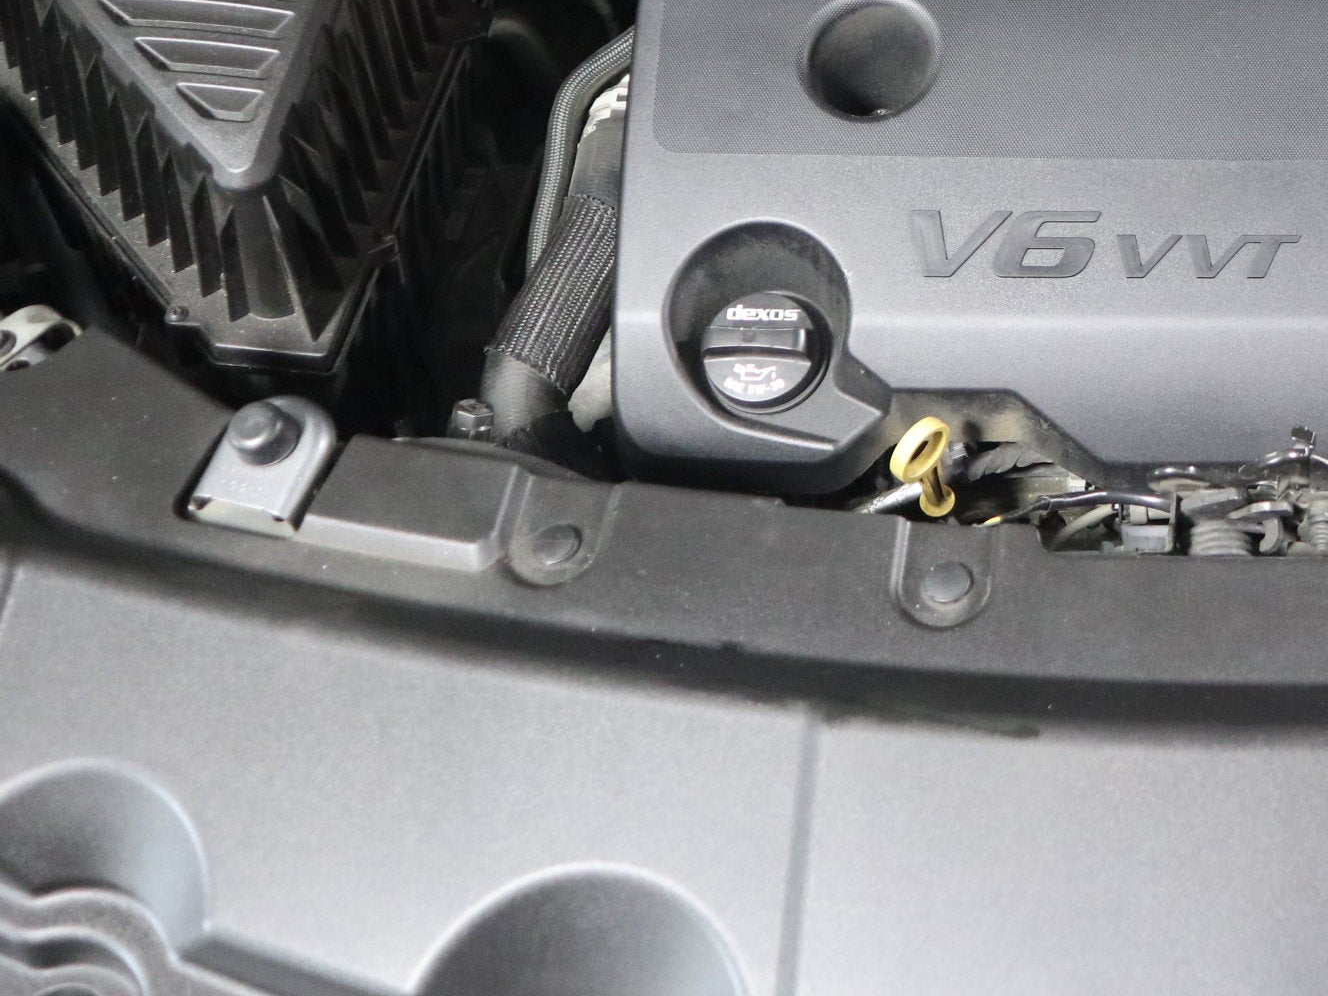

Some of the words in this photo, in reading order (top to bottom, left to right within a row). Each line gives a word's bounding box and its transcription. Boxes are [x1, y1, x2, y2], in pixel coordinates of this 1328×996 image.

[911, 210, 1103, 279] V6
[1117, 234, 1302, 279] VVT
[726, 304, 801, 321] dexos
